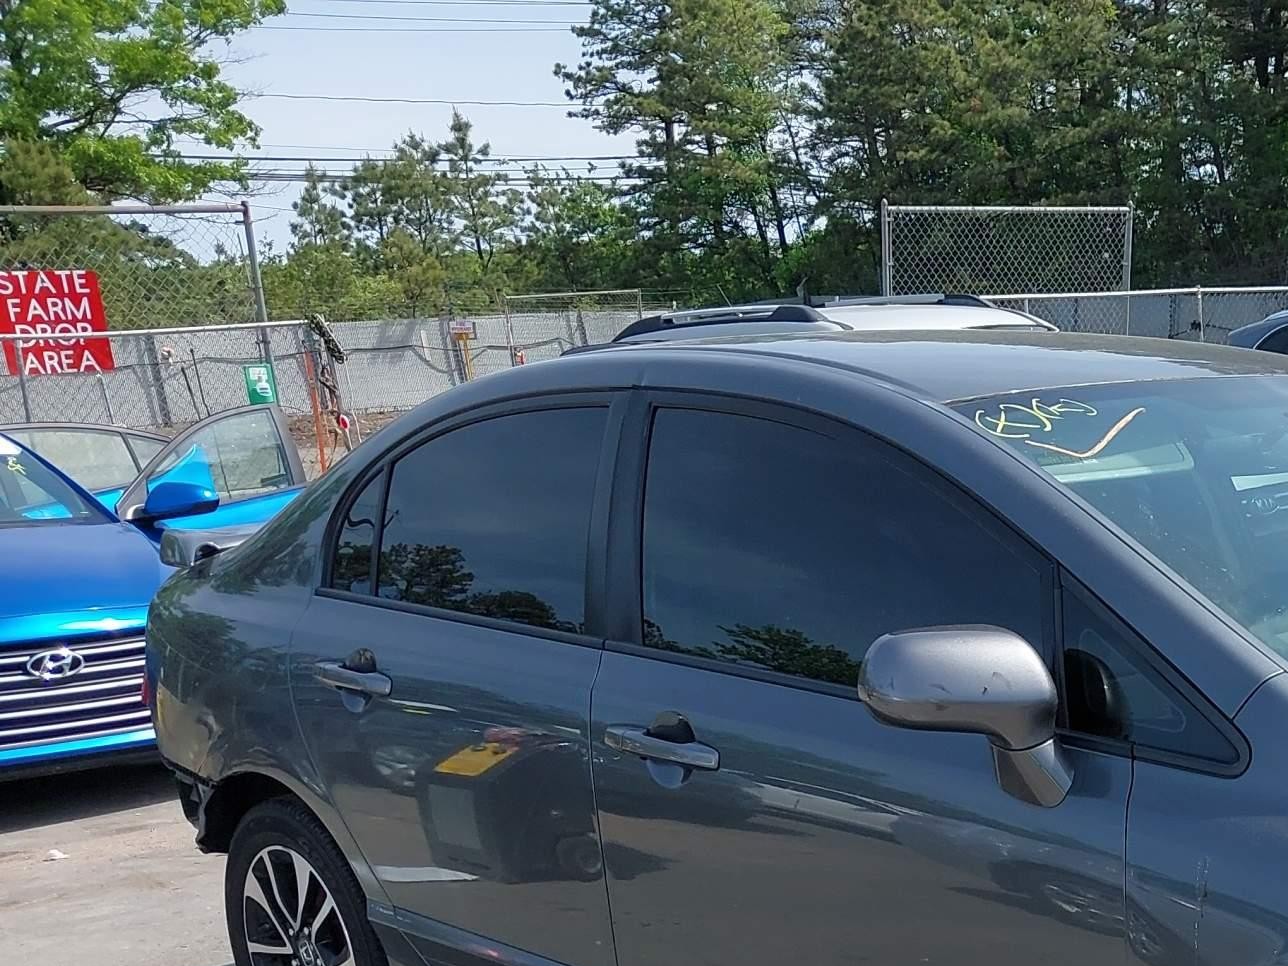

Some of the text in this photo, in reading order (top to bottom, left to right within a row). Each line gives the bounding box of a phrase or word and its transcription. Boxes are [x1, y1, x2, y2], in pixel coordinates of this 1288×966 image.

[0, 270, 91, 295] STATE
[6, 296, 92, 322] FARM
[14, 322, 93, 348] DROP
[24, 349, 103, 375] AREA
